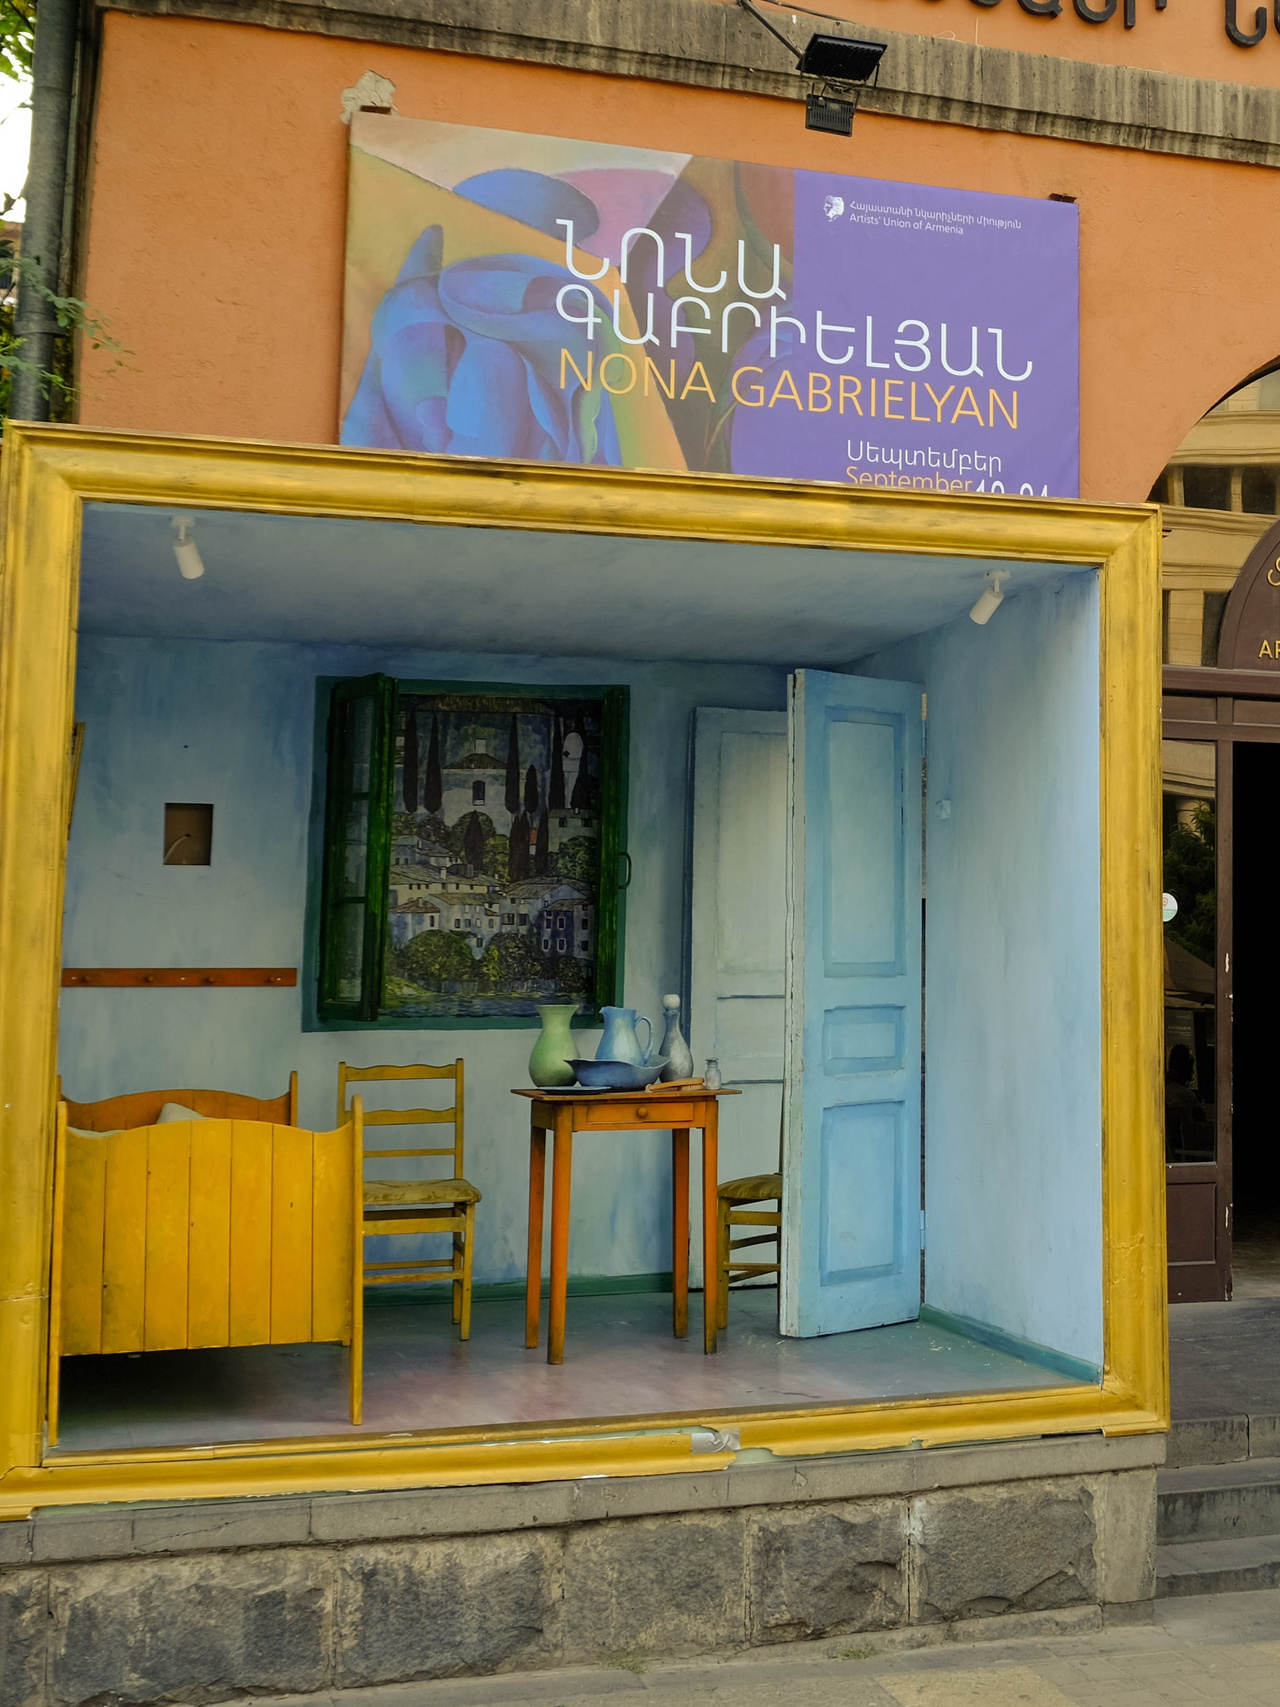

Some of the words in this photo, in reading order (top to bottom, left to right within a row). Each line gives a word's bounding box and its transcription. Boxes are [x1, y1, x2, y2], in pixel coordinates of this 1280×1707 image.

[849, 200, 913, 217] Հայաստանի
[883, 217, 911, 228] Union
[913, 219, 923, 230] of
[924, 222, 964, 235] Armenia
[556, 218, 787, 301] ՆՈՆԱ
[556, 284, 1033, 382] ԳԱԲՐԻԵԼՅԱՆ
[560, 348, 717, 404] NONA
[731, 366, 1018, 430] GABRIELYAN
[847, 439, 1002, 478] Սեպտեմբեր
